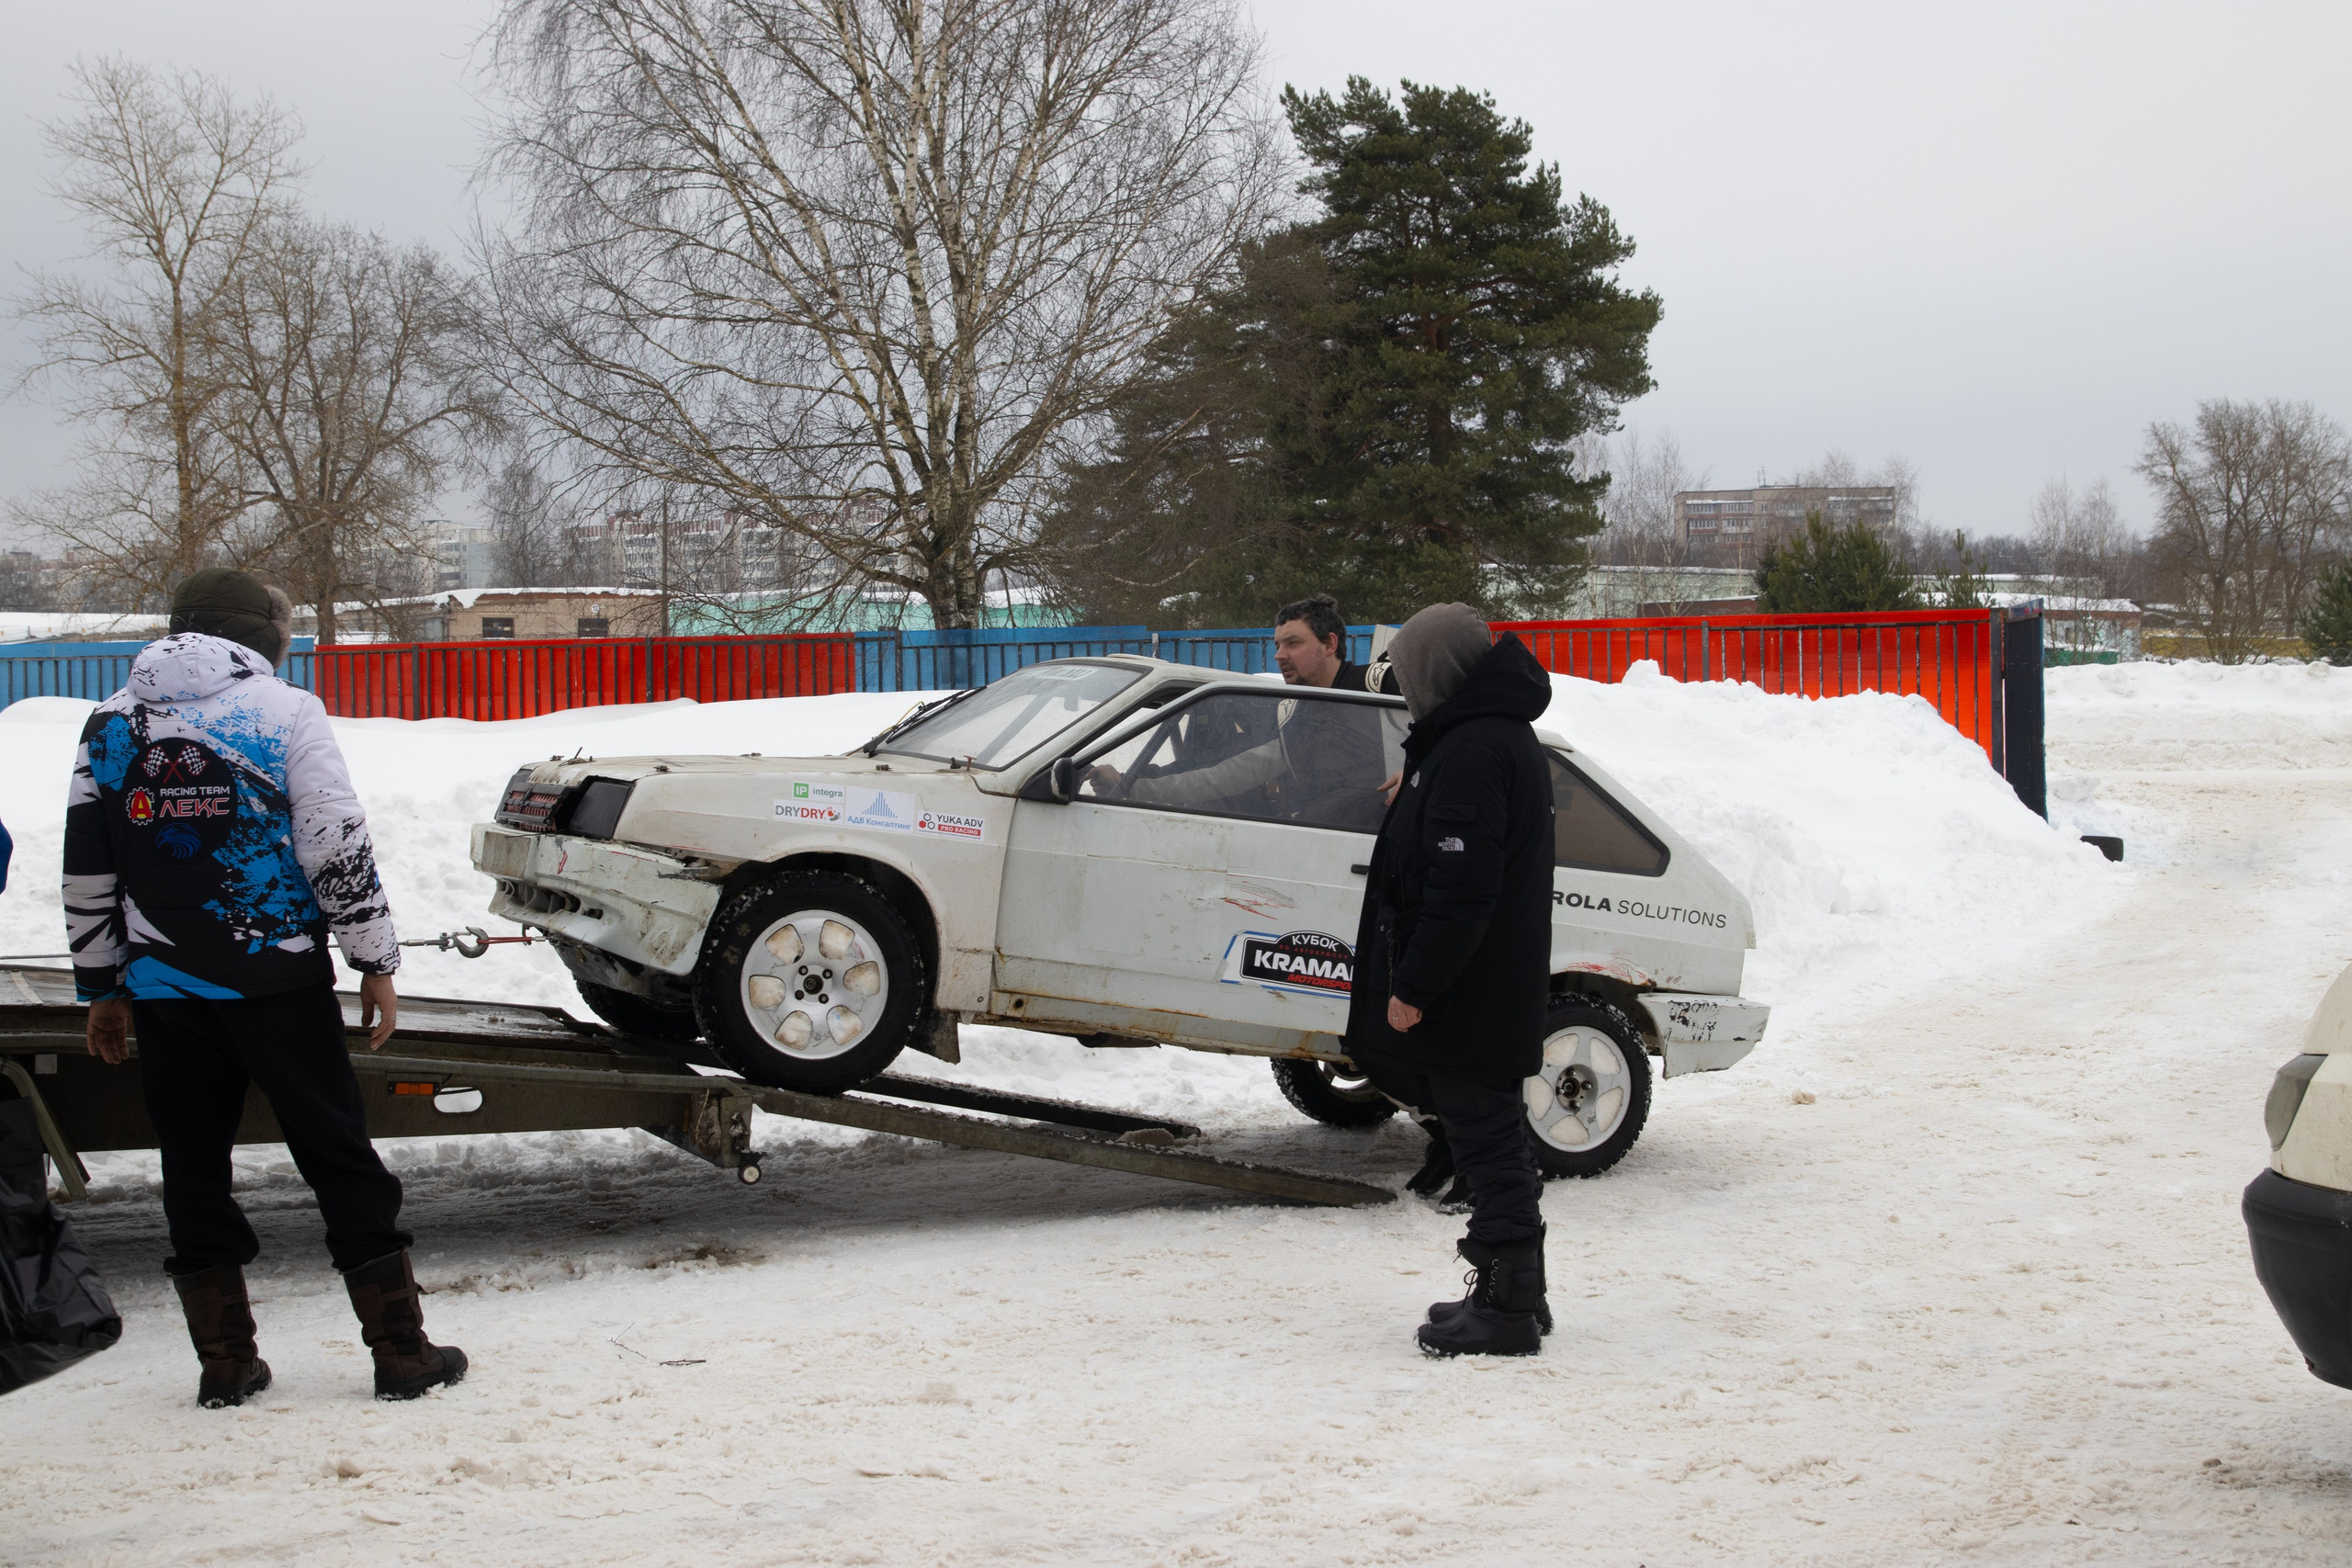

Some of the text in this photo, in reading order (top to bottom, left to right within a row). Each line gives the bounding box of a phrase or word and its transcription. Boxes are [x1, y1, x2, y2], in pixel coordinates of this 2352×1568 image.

[160, 786, 231, 796] RACING TEAM
[796, 785, 807, 795] IP
[812, 787, 843, 798] integra
[847, 816, 912, 830] АДВ Консалтинг
[937, 814, 984, 828] YUKA ADV
[955, 827, 978, 835] RACING
[1617, 899, 1727, 929] SOLUTIONS
[1292, 934, 1340, 952] КУБОК
[1294, 946, 1349, 960] АВТОКРОССУ
[1254, 949, 1354, 982] KRAMA
[1286, 974, 1352, 991] MOTORSPO
